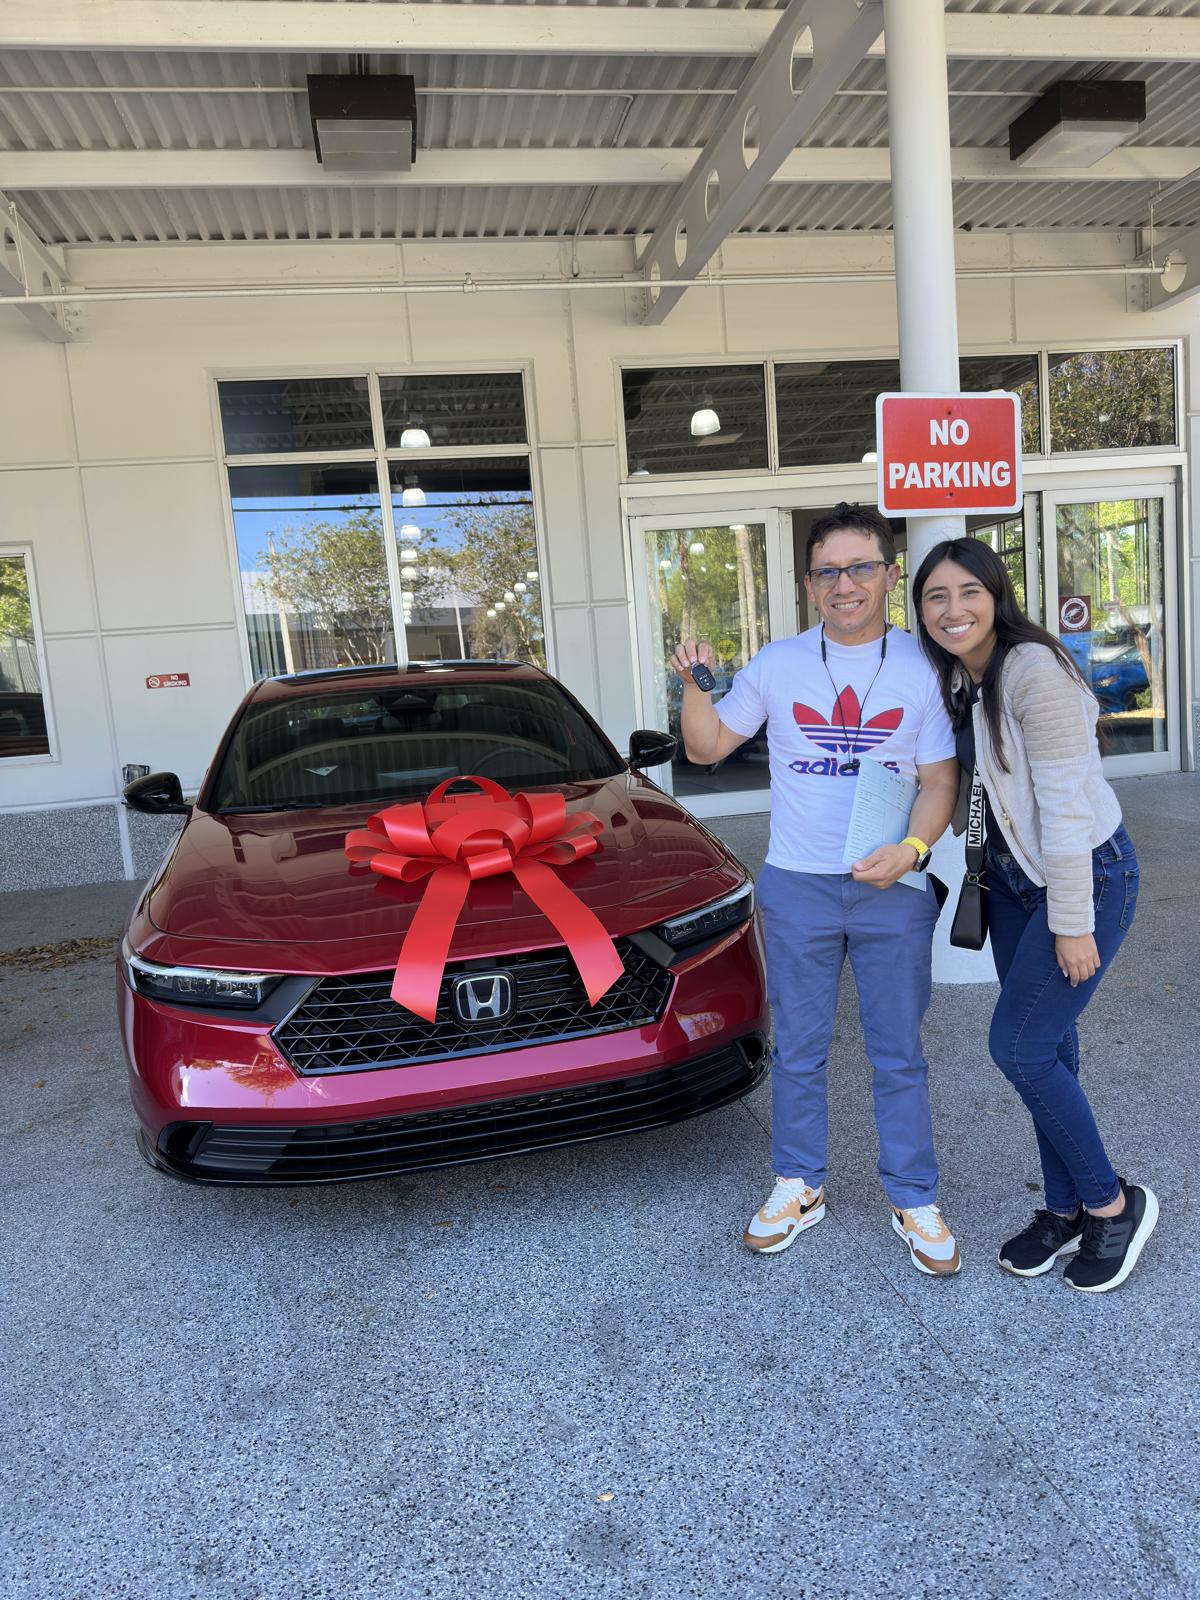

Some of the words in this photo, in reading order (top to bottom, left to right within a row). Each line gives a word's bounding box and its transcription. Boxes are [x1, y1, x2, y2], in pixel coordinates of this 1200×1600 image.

[929, 418, 970, 446] NO
[888, 460, 1011, 489] PARKING
[789, 757, 900, 777] adids
[969, 782, 982, 845] MICHAEL
